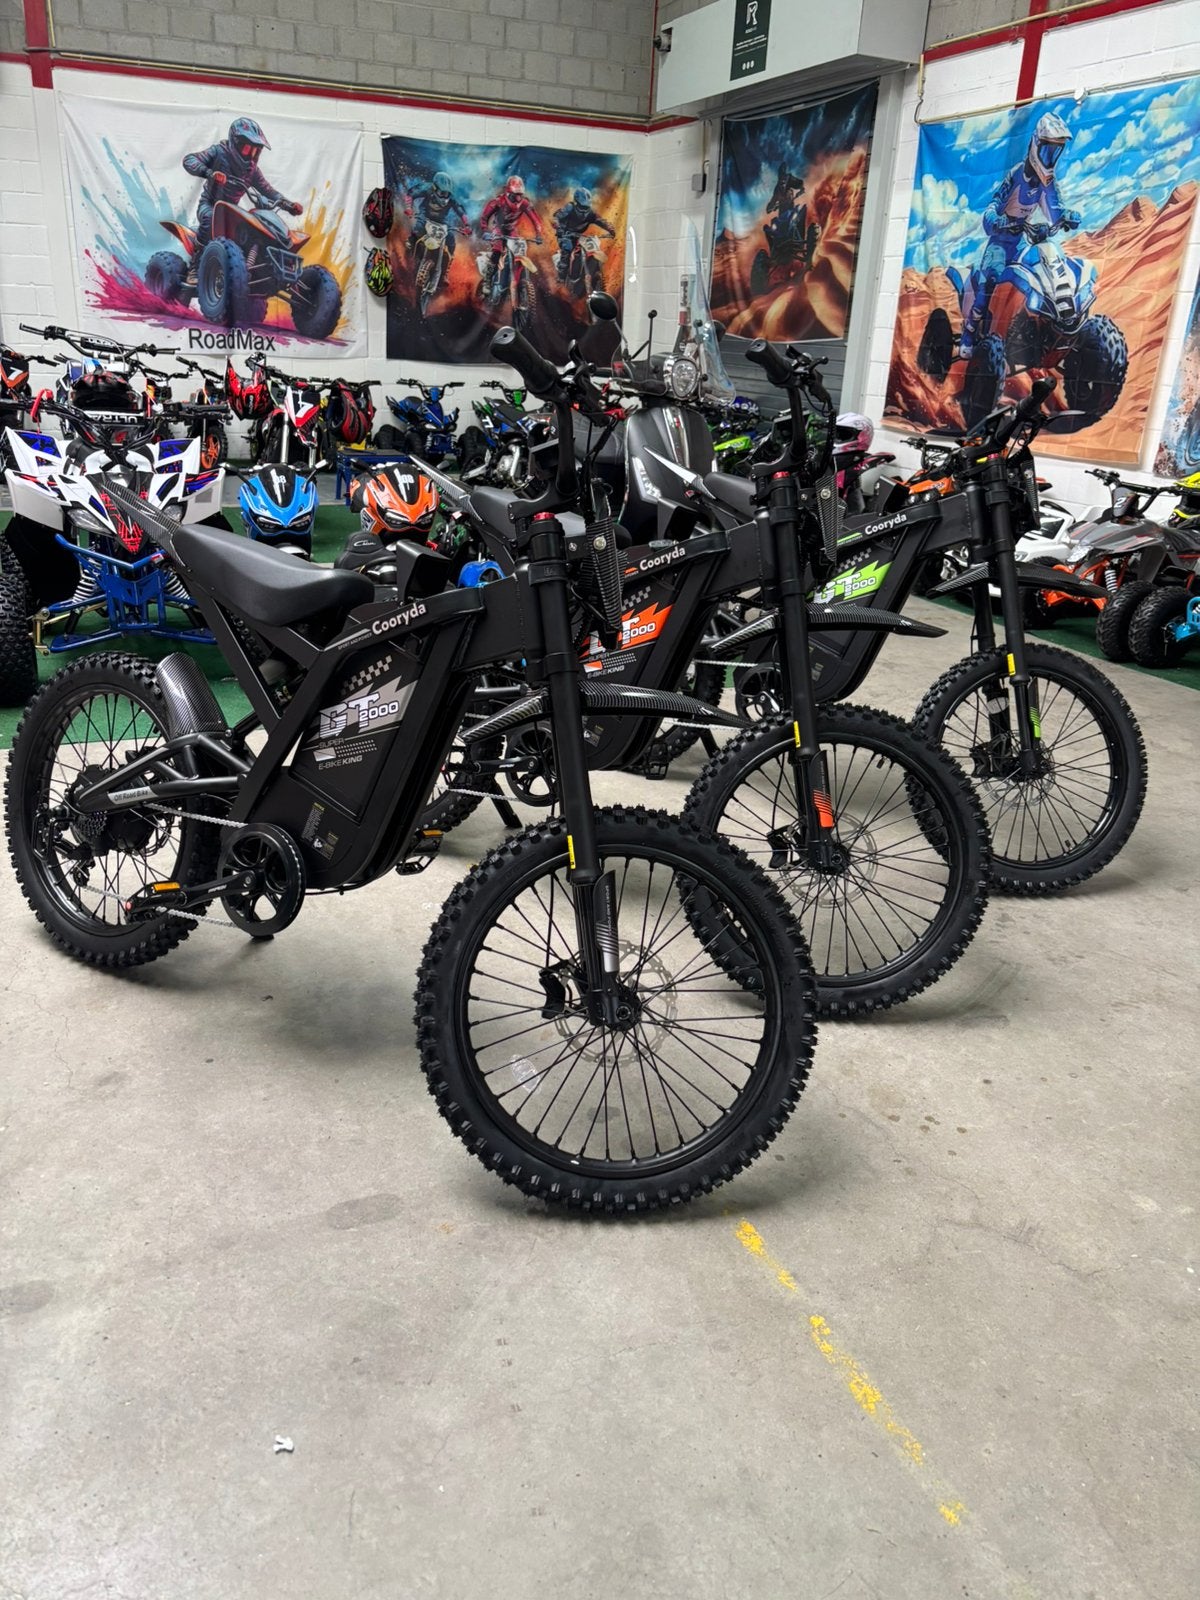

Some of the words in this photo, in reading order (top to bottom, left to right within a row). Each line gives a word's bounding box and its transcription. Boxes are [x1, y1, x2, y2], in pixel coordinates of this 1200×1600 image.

[188, 327, 276, 352] RoadMax
[8, 366, 24, 381] 7
[1114, 497, 1126, 508] 2
[865, 513, 907, 535] Cooryda
[640, 547, 686, 571] Cooryda
[844, 577, 876, 593] 2000
[372, 603, 427, 635] Cooryda
[622, 622, 656, 639] 2000
[607, 665, 625, 674] KING
[320, 691, 380, 739] GT
[359, 701, 399, 723] 2000
[319, 738, 345, 748] SUPER
[318, 760, 341, 770] E-BIKE
[342, 755, 363, 765] KING
